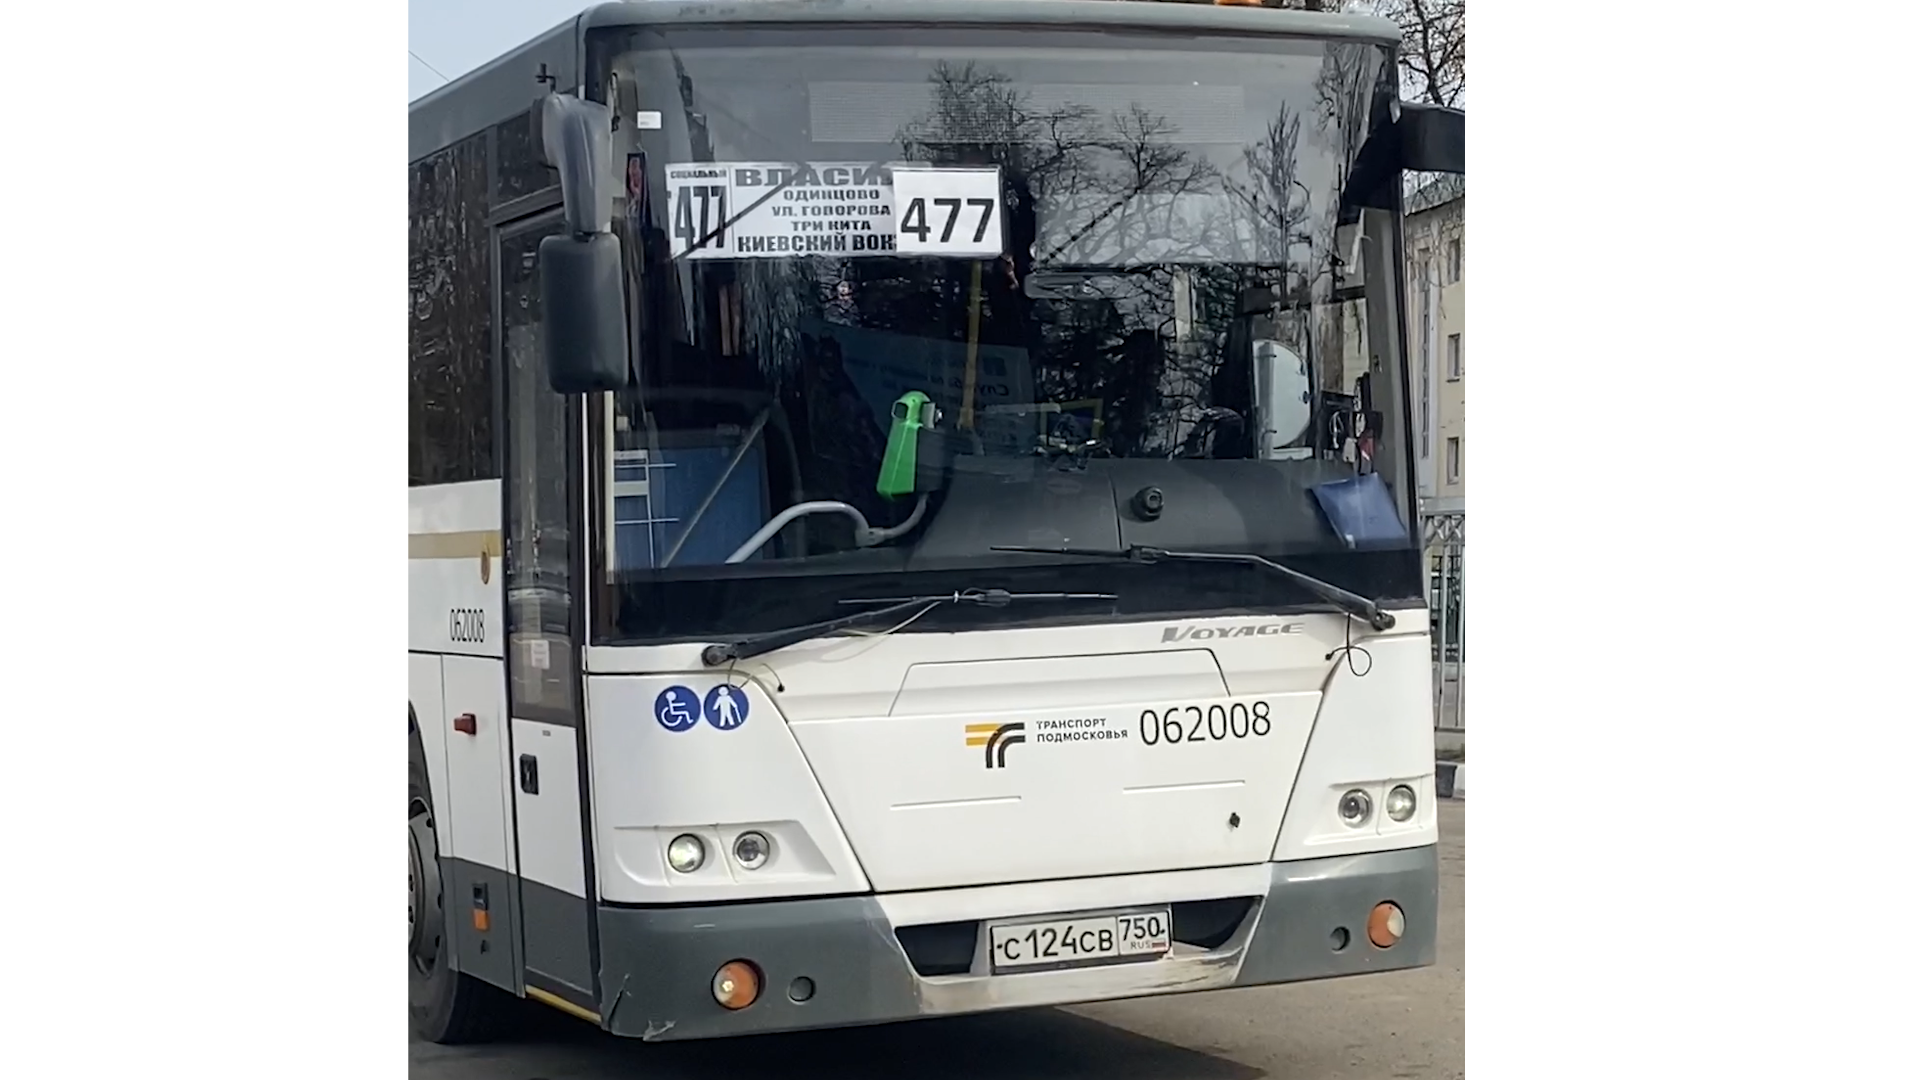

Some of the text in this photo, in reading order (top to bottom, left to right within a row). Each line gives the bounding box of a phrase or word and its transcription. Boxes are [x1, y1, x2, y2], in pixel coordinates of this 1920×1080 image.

[783, 189, 881, 202] ОДИНЦОВО
[675, 185, 727, 250] 477
[772, 204, 892, 217] УЛ. ГОВОРОВА
[791, 220, 872, 232] ТРИ КИТА
[900, 197, 995, 243] 477
[738, 232, 897, 252] КИЕВСКИЙ ВОК
[450, 608, 485, 643] 062008
[1036, 717, 1107, 729] ТРАНСПОРТ
[1139, 701, 1271, 746] 062008
[1036, 729, 1129, 743] ПОДМОСКОВЬЯ
[1118, 917, 1161, 941] 750
[1130, 941, 1151, 950] RUS
